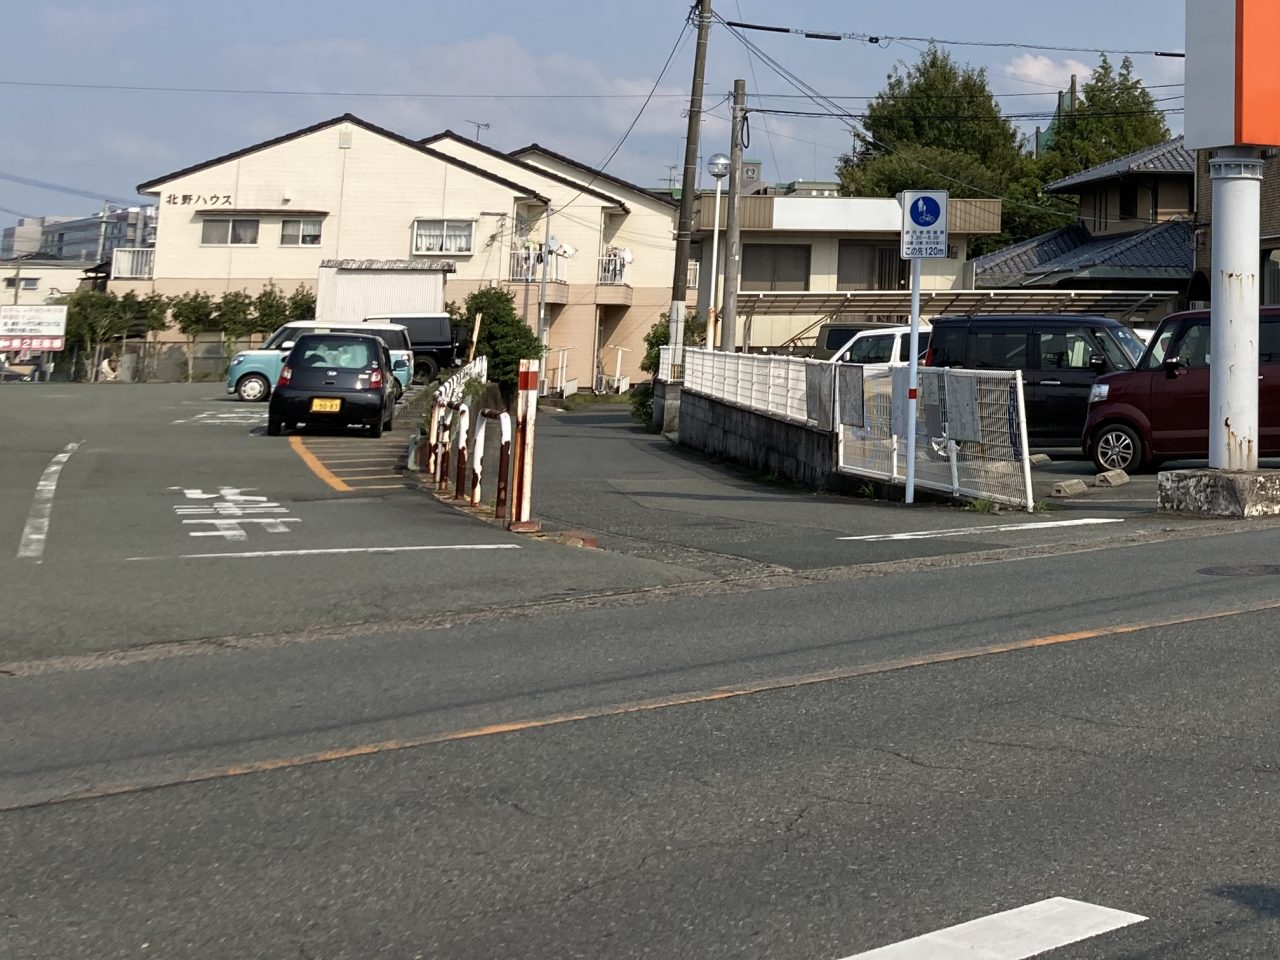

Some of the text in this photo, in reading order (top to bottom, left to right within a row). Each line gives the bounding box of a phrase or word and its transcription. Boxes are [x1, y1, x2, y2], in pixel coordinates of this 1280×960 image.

[166, 193, 232, 206] 北野ハウス
[905, 246, 944, 256] この先120m
